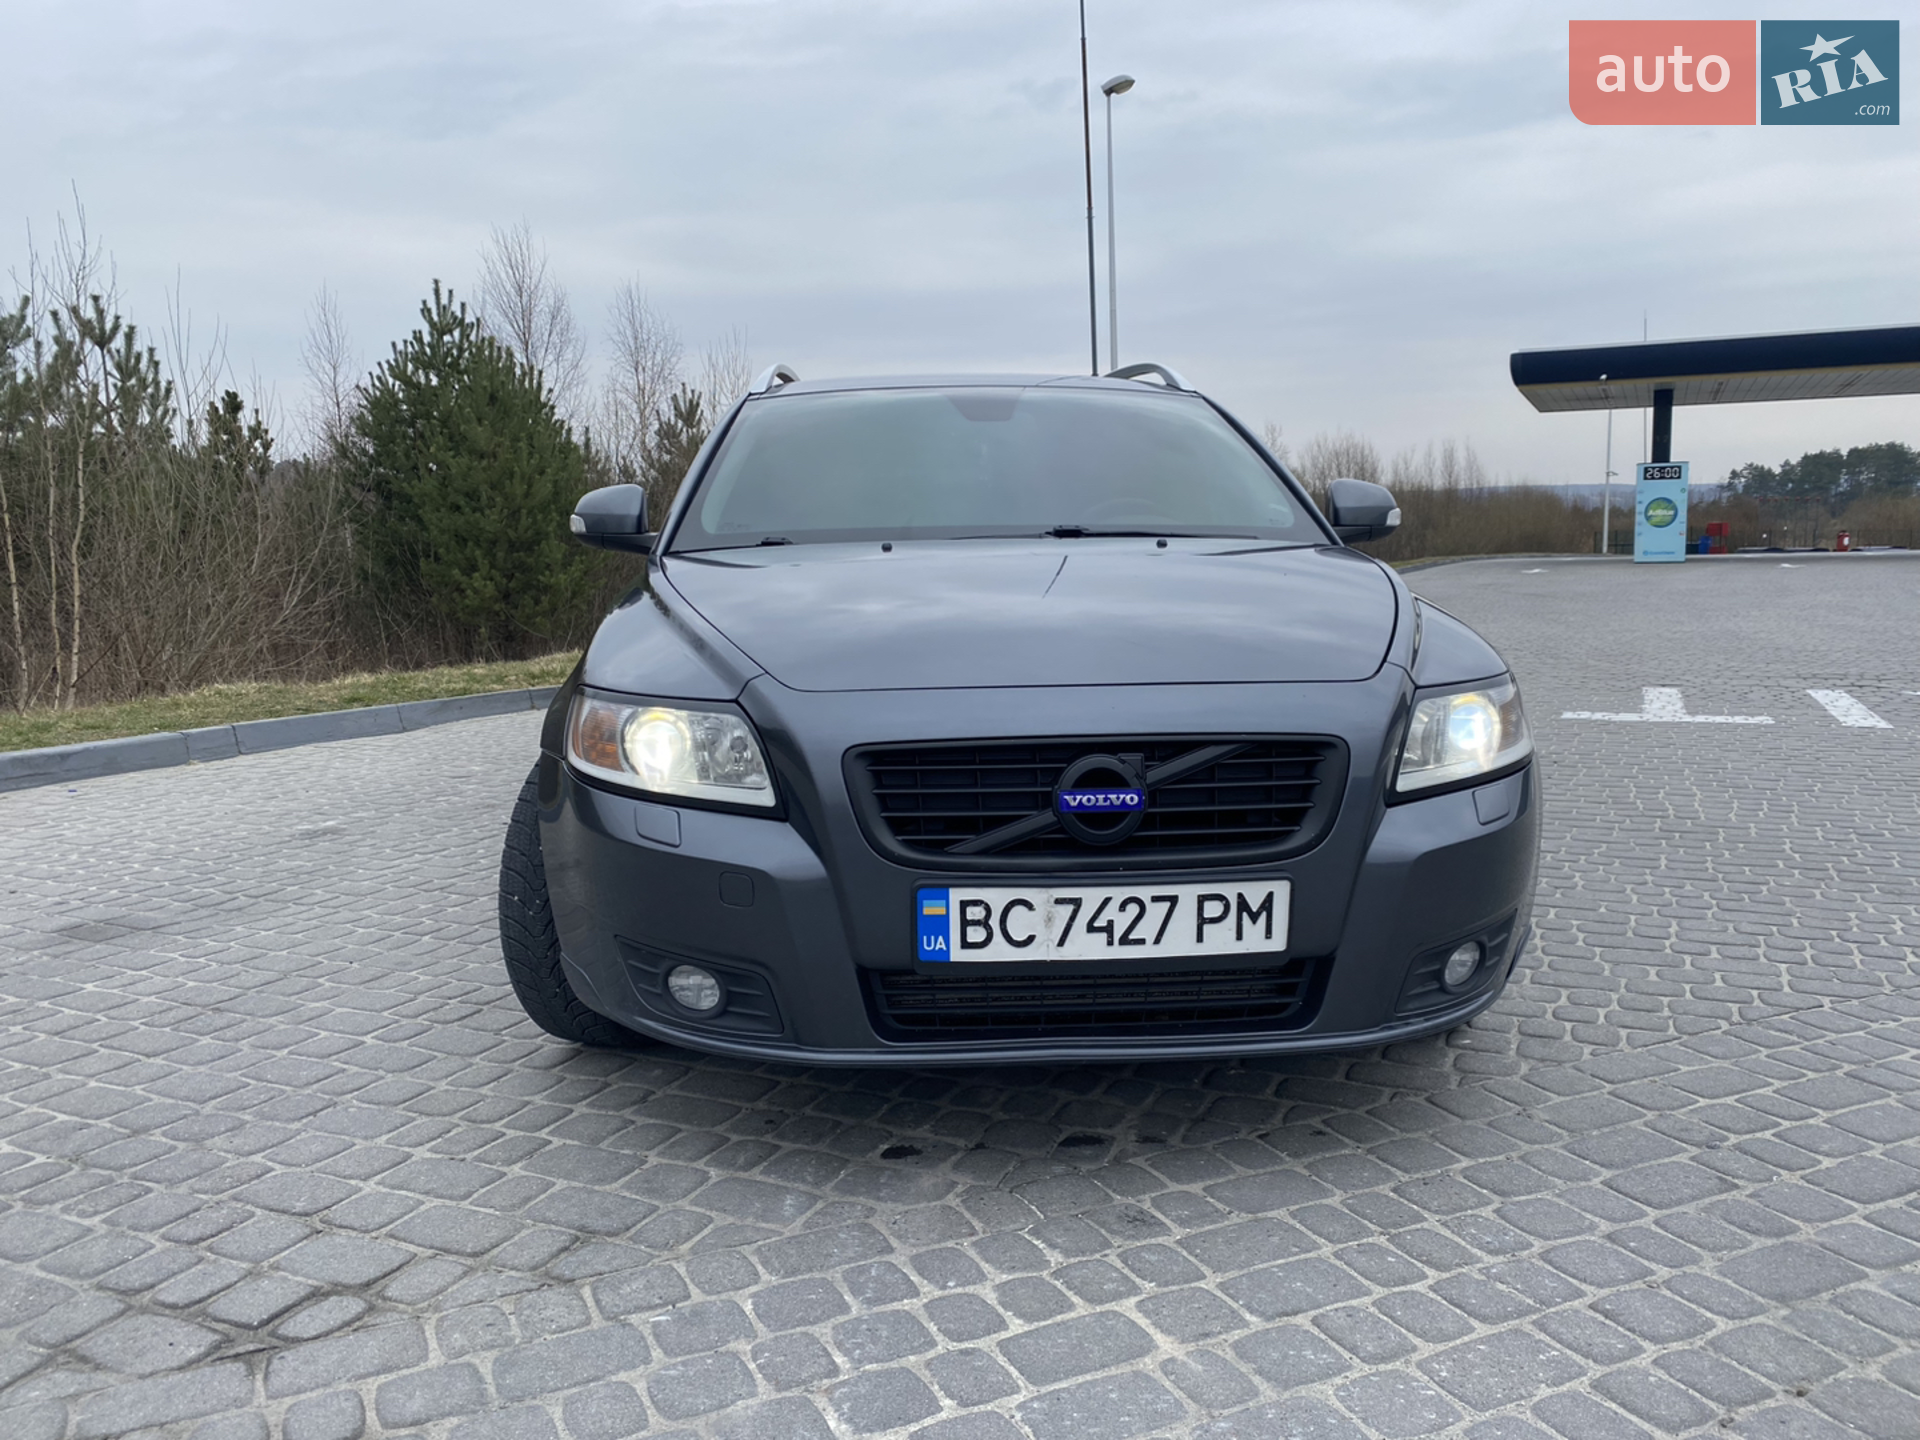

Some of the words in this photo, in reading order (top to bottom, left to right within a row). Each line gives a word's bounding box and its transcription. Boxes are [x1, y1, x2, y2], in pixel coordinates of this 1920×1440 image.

[1646, 467, 1680, 479] 26:00
[1063, 793, 1139, 807] VOLVO
[959, 897, 1037, 950] BC
[1053, 894, 1180, 948] 7427
[1196, 891, 1275, 944] PM
[923, 935, 947, 951] UA
